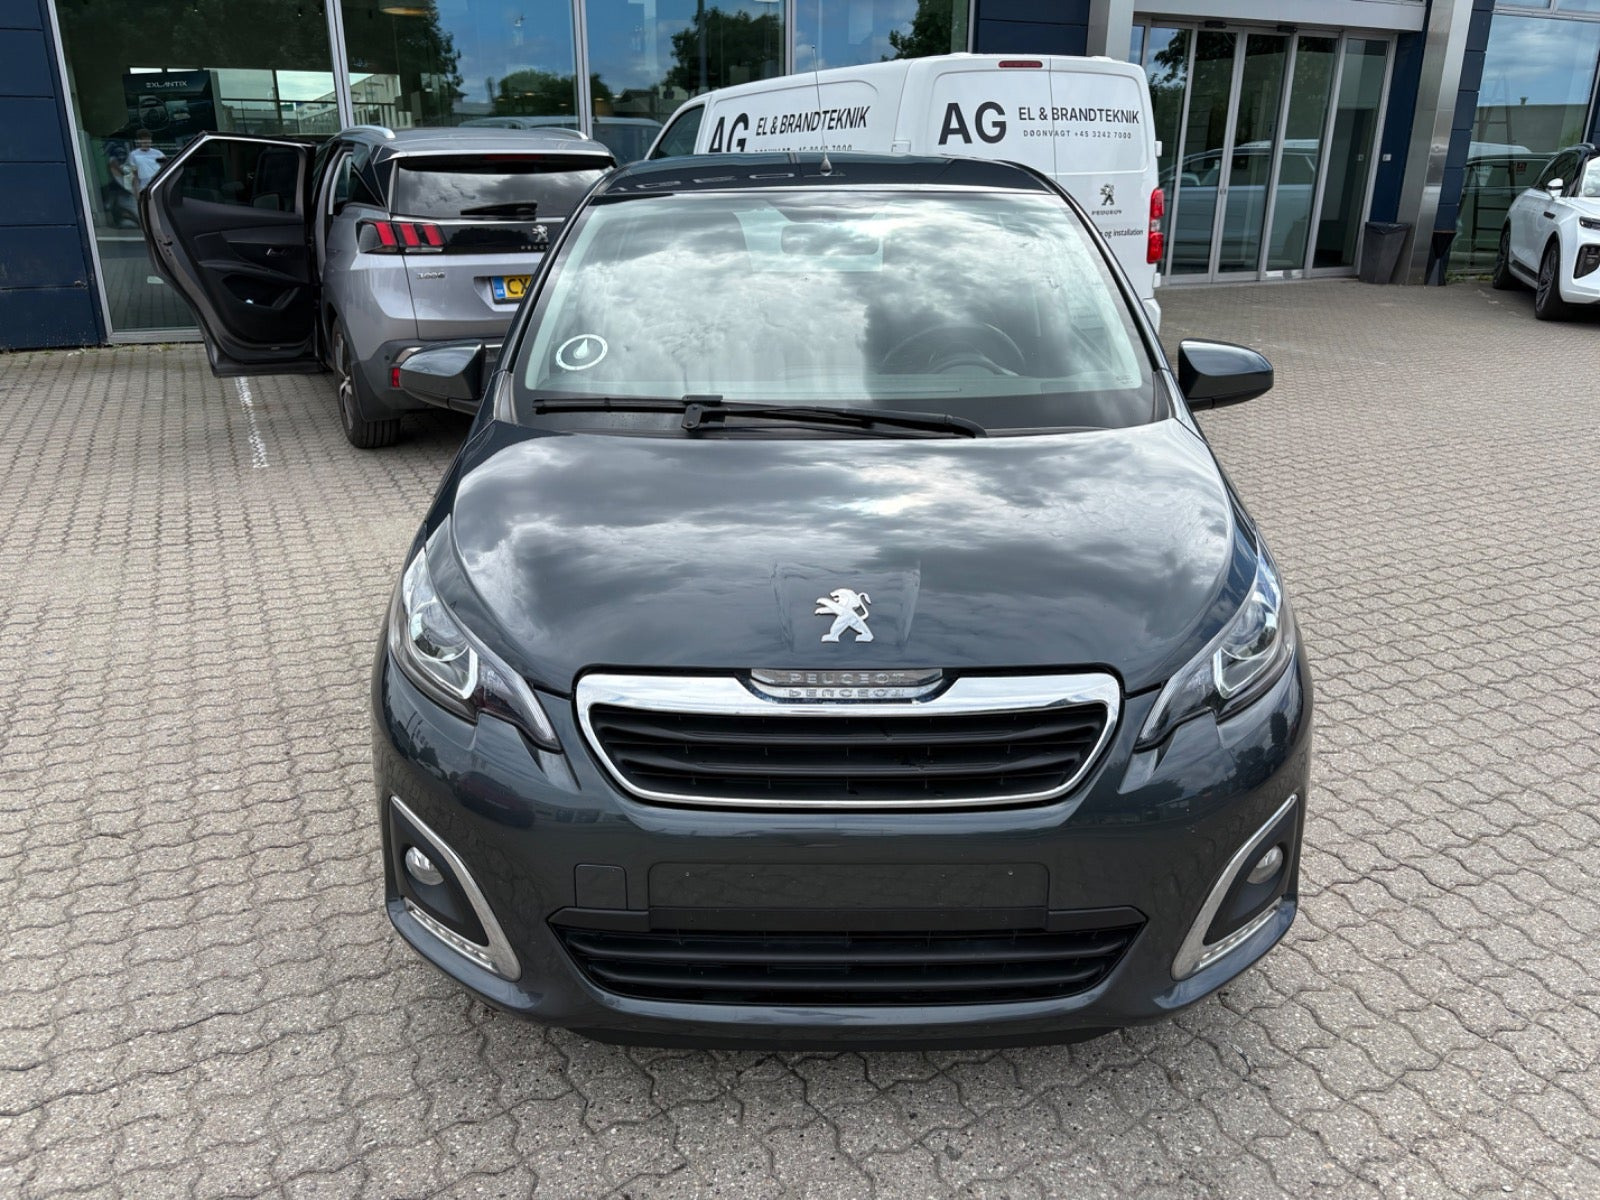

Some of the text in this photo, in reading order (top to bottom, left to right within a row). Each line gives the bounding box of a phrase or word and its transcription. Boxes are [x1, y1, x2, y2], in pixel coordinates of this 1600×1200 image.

[755, 105, 871, 136] EL & BRANDTEKNIK
[938, 101, 1007, 146] AG
[1018, 106, 1140, 124] EL & BRANDTEKNIK
[708, 112, 750, 153] AG
[1023, 129, 1071, 138] DØGNVAGT
[1074, 130, 1089, 138] +45
[1113, 228, 1144, 237] installation
[788, 672, 905, 684] PEUGEOT
